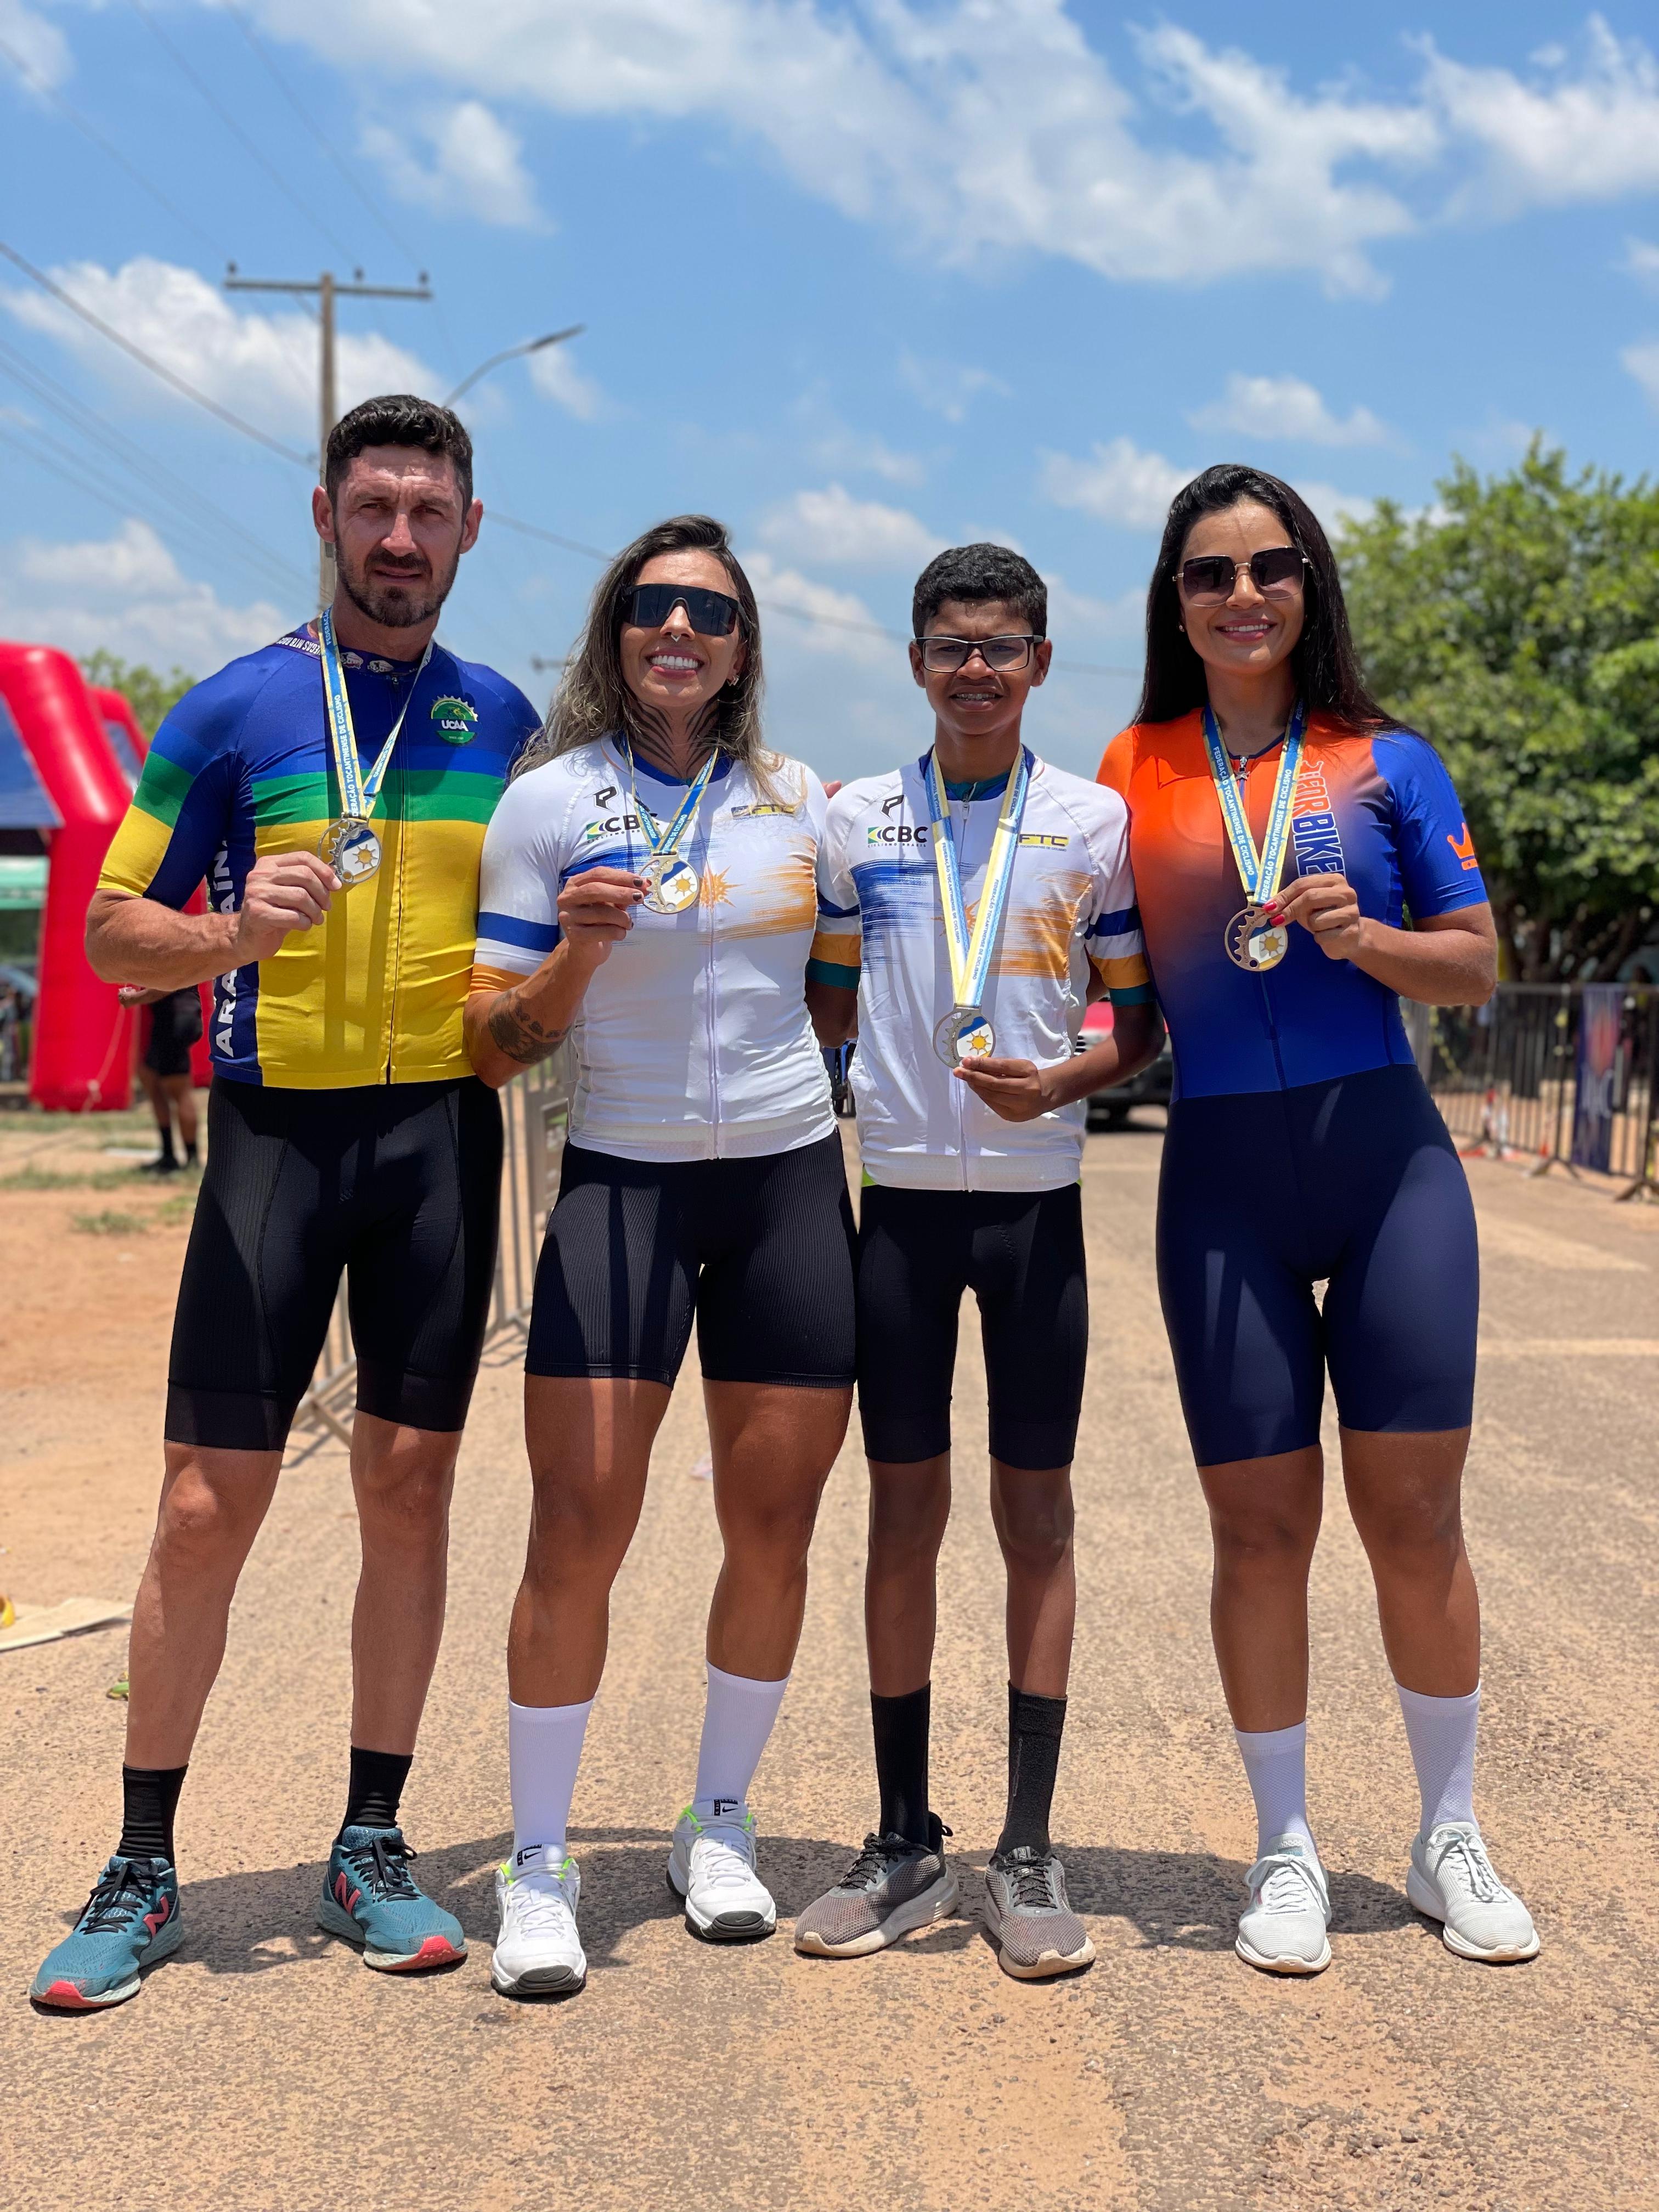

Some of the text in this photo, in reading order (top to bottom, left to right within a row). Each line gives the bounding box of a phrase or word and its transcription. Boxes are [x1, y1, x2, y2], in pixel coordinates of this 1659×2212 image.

[335, 694, 359, 817] DERAÇÃO TOCANTINENSE DE CICLISMO
[441, 719, 469, 732] UCAA
[605, 813, 659, 832] CB
[882, 826, 928, 843] CBC
[1019, 834, 1068, 847] FTC
[1213, 746, 1255, 876] FEDERAÇÃO TOCANTINENSE DE CICLISMO
[1261, 769, 1291, 902] FEDERAÇÃO TOCANTINENSE DE CICLISMO
[941, 842, 951, 873] FEDERAÇÃO
[946, 873, 956, 912] TOCANTINENSE
[972, 879, 999, 980] FEDERAÇÃO TOCANTINENSE DE CICLISMO
